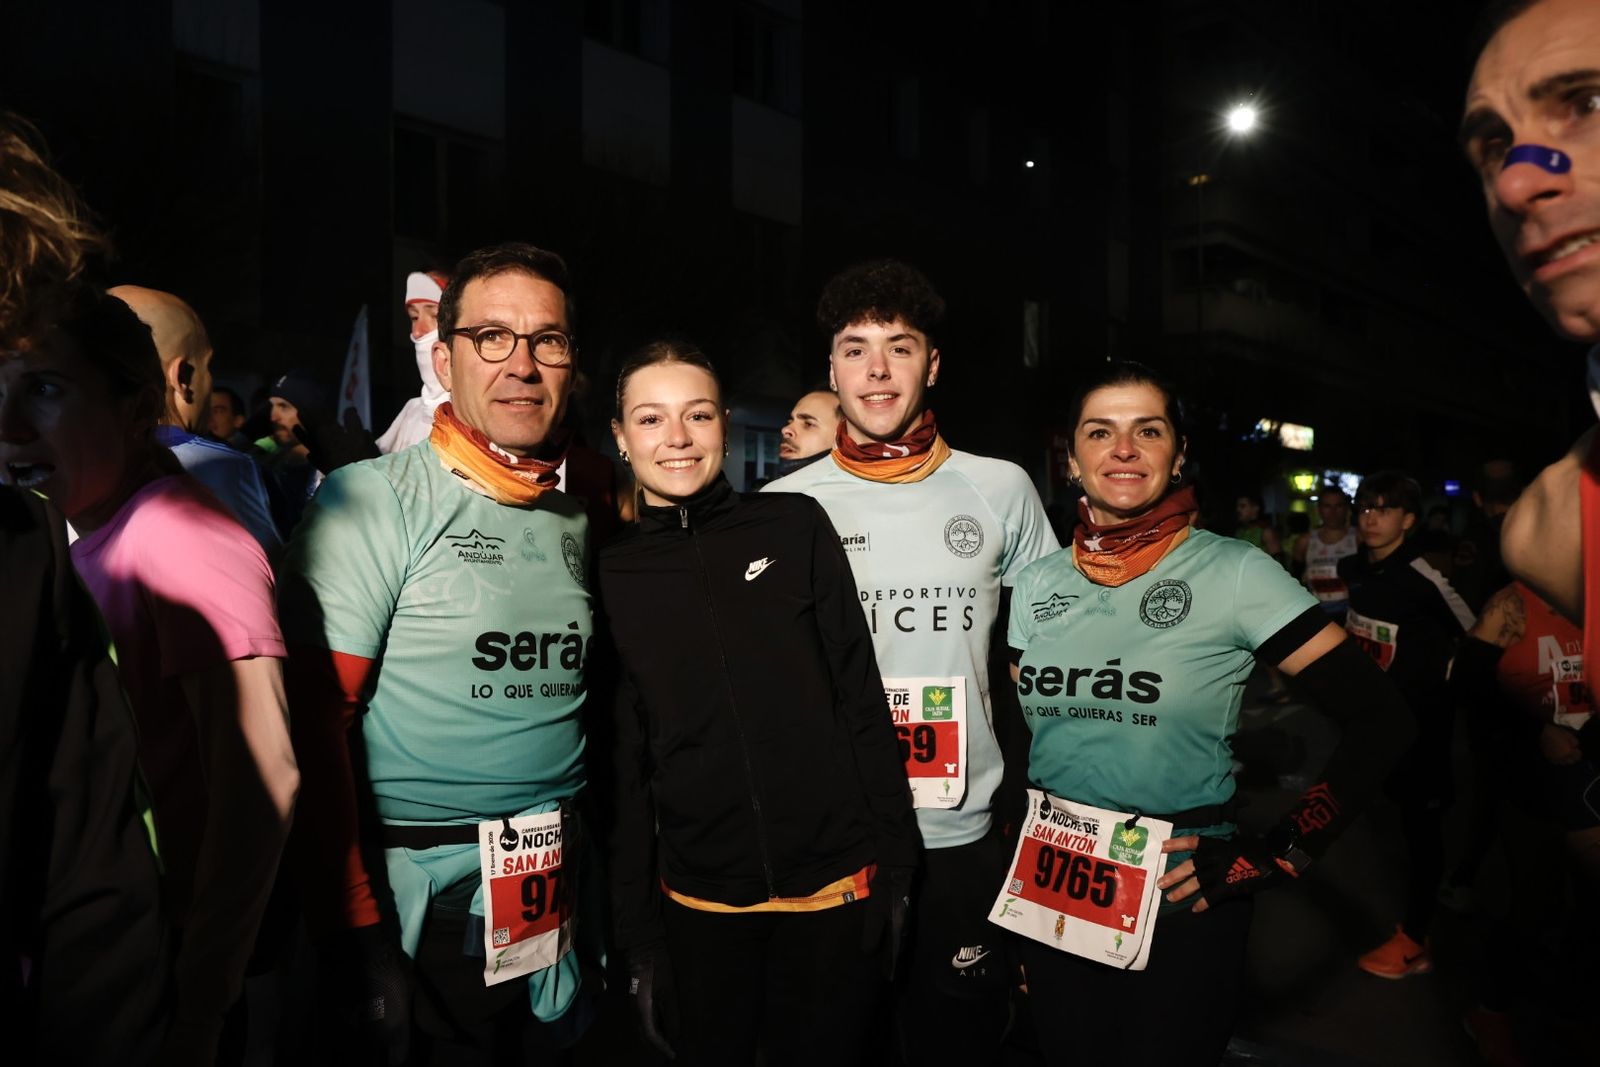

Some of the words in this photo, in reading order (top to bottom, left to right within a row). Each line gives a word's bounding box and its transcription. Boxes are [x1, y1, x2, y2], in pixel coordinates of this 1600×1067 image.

[840, 533, 866, 545] aría
[457, 550, 504, 561] ANDÚJAR
[860, 587, 977, 601] DEPORTIVO
[870, 603, 974, 634] ÍCES
[471, 685, 493, 698] LO
[504, 684, 534, 698] QUE
[1018, 658, 1163, 704] serás
[894, 693, 909, 705] DE
[1037, 706, 1061, 717] QUE
[1068, 707, 1123, 722] QUIERAS
[1132, 713, 1157, 726] SER
[896, 725, 936, 763] 69
[1050, 810, 1082, 832] NOCHE
[1083, 822, 1100, 835] DE
[522, 829, 562, 850] NOCH
[1033, 824, 1056, 842] SAN
[1054, 833, 1097, 854] ANTÓN
[503, 853, 537, 875] SAN
[1034, 844, 1119, 908] 9765
[1225, 869, 1261, 884] adidas
[521, 871, 560, 922] 97
[957, 945, 983, 960] NIKE
